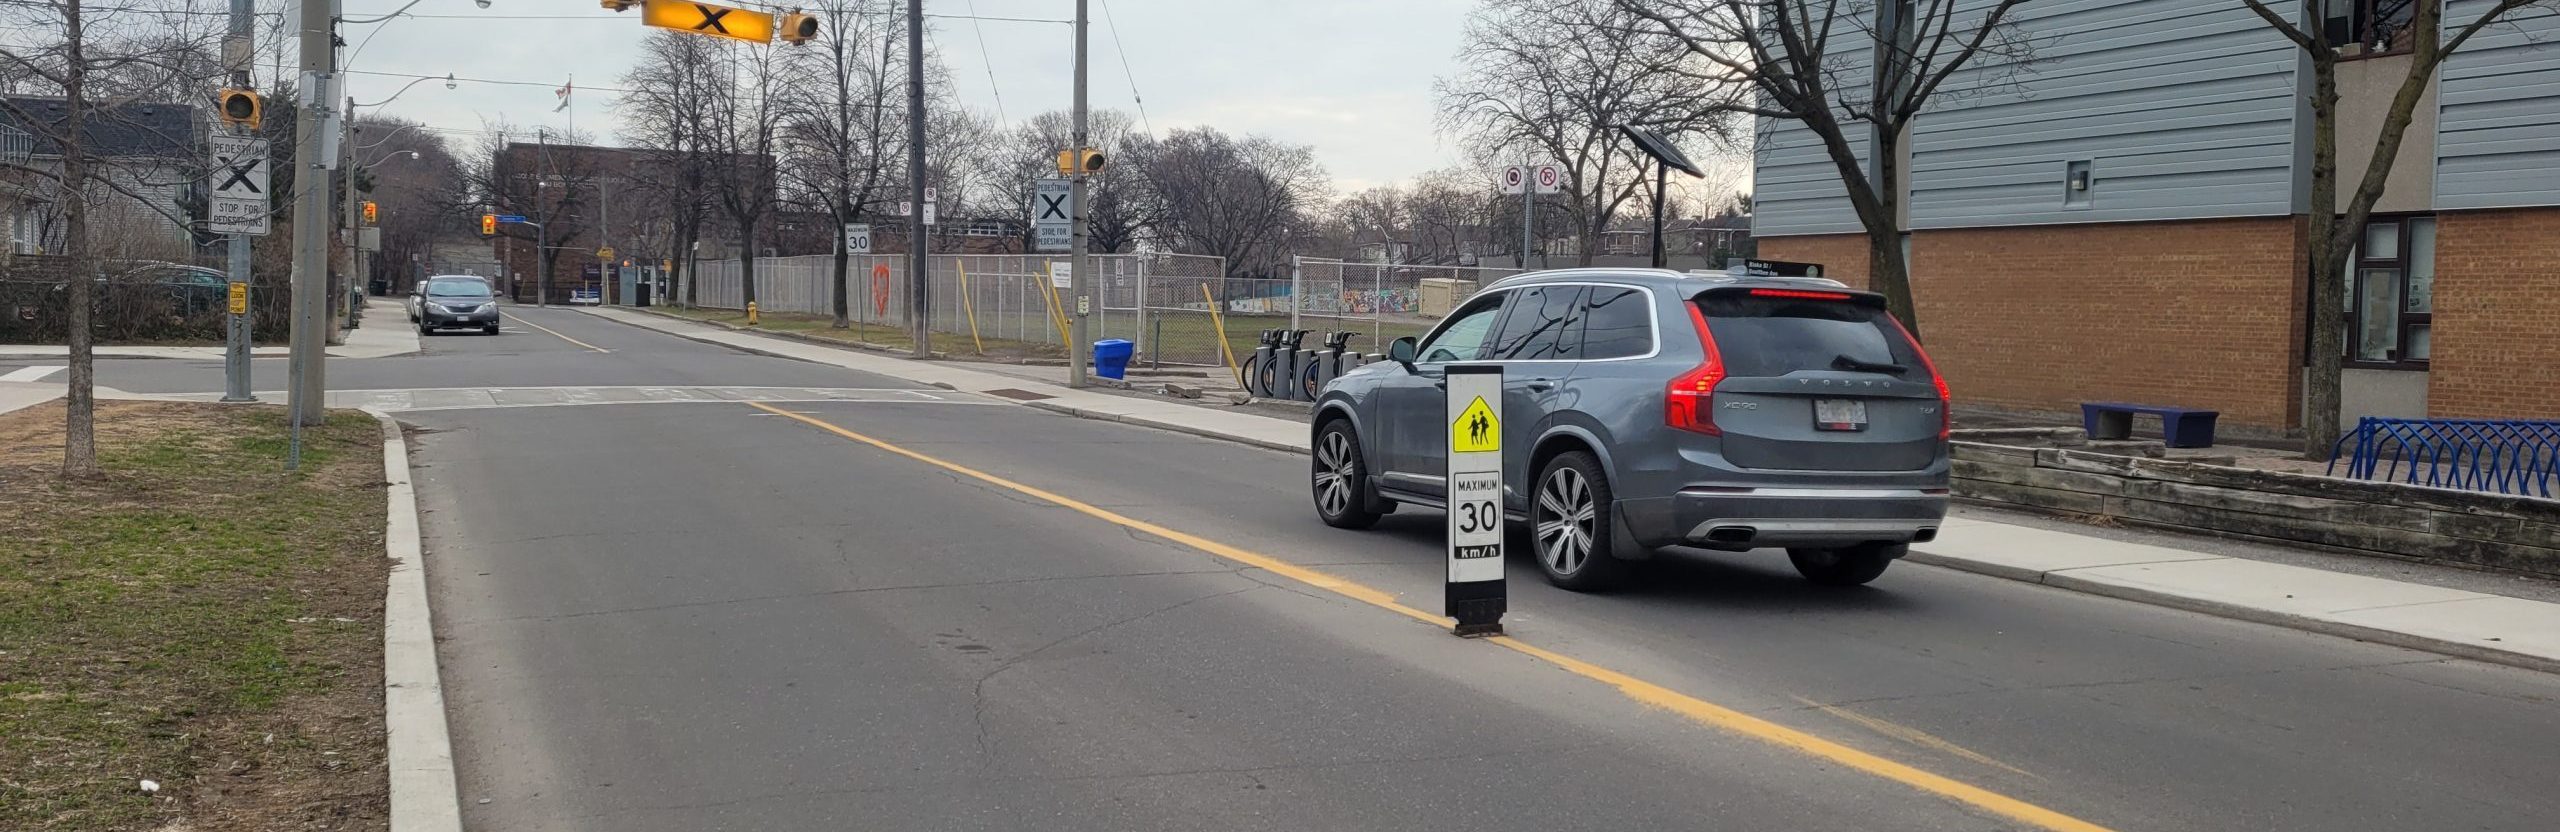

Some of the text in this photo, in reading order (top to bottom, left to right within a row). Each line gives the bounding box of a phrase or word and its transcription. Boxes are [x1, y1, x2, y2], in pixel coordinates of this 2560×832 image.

[214, 143, 265, 156] PEDESTRIAN
[1038, 184, 1070, 192] PEDESTRIAN
[219, 202, 259, 214] STOP FOR
[214, 215, 263, 228] PEDESTRIANS
[1042, 228, 1067, 236] STOP FOR
[849, 236, 868, 249] 30
[1038, 238, 1072, 246] PEDESTRIANS
[1799, 378, 1891, 389] VOLVO
[1723, 401, 1757, 410] XC90
[1458, 480, 1497, 491] MAXIMUM
[1459, 501, 1497, 533] 30
[1461, 546, 1496, 558] km/h
